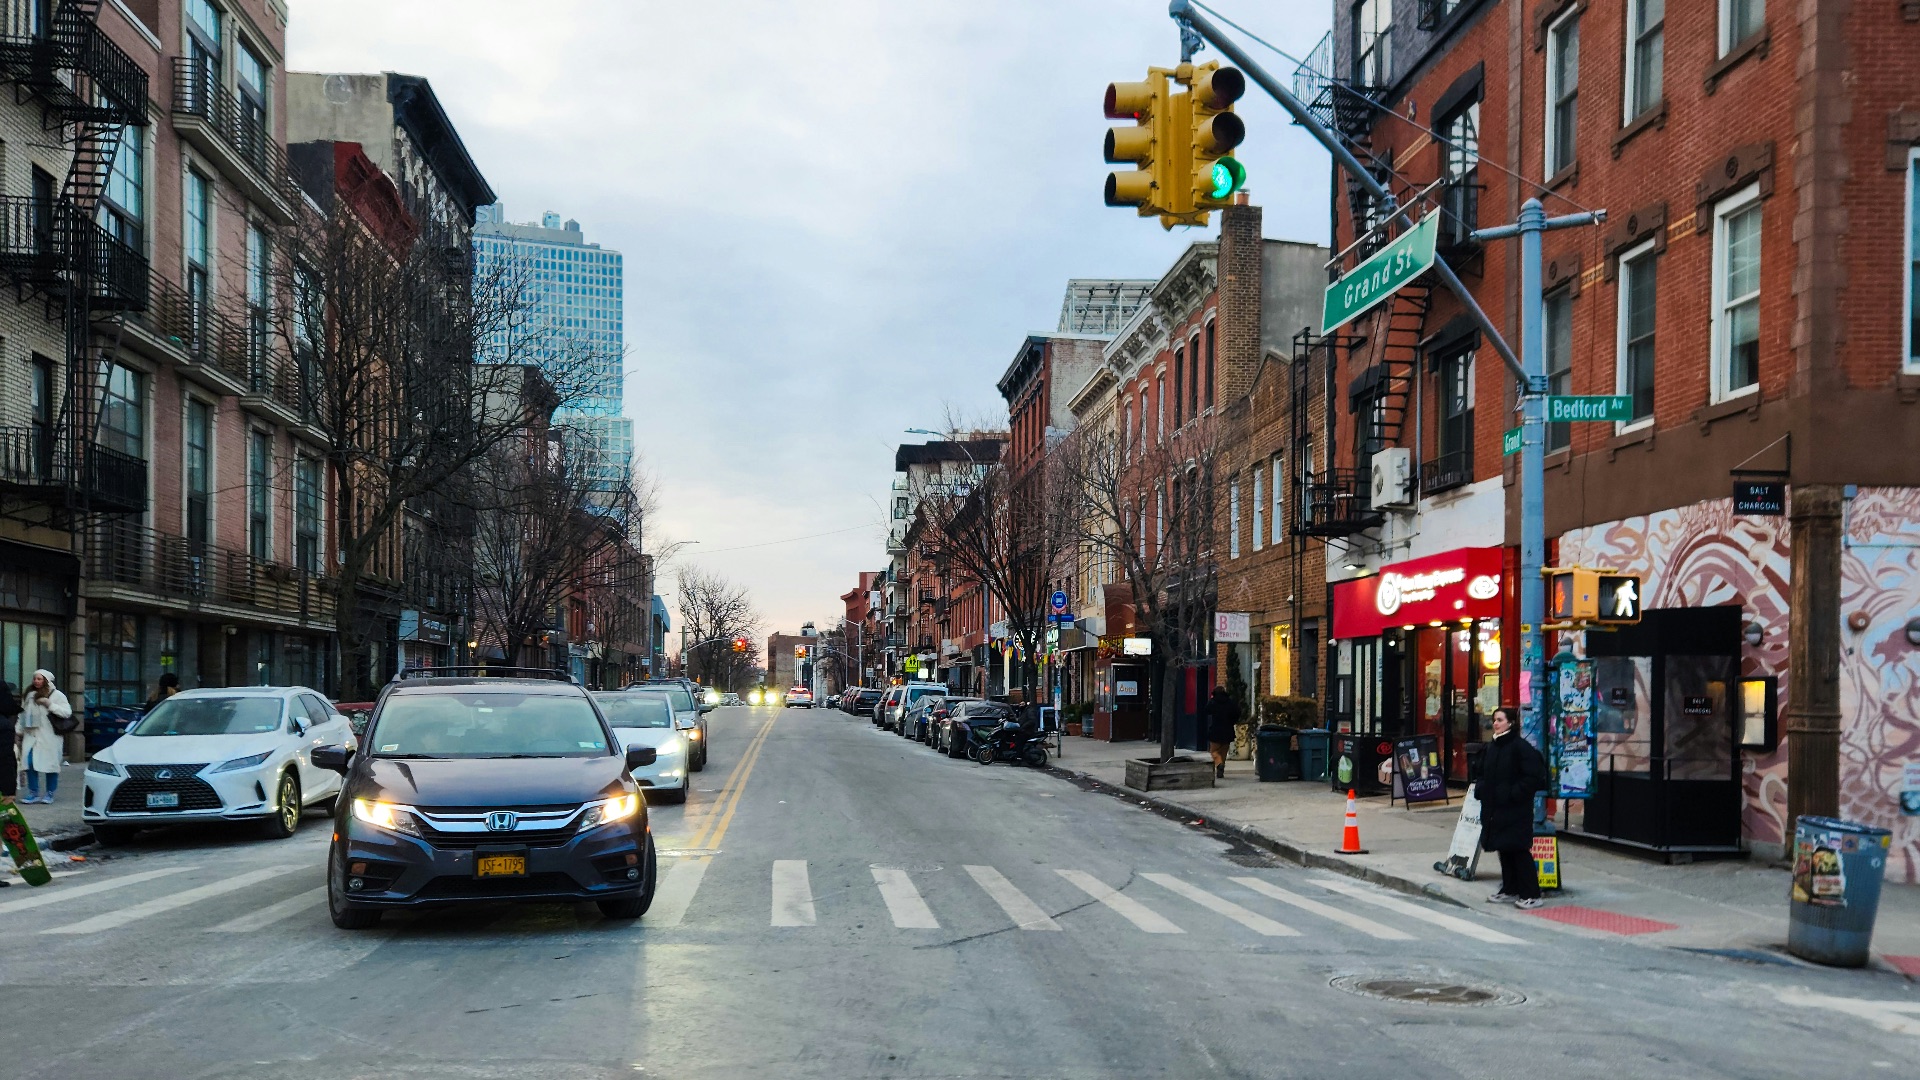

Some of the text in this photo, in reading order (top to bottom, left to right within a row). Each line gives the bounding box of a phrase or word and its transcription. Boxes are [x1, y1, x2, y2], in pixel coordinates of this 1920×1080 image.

[1344, 243, 1413, 309] Grand St
[1553, 398, 1623, 419] Bedford Av
[1505, 430, 1520, 453] Grand
[1750, 486, 1769, 495] SALT
[1738, 501, 1780, 510] CHARCOAL
